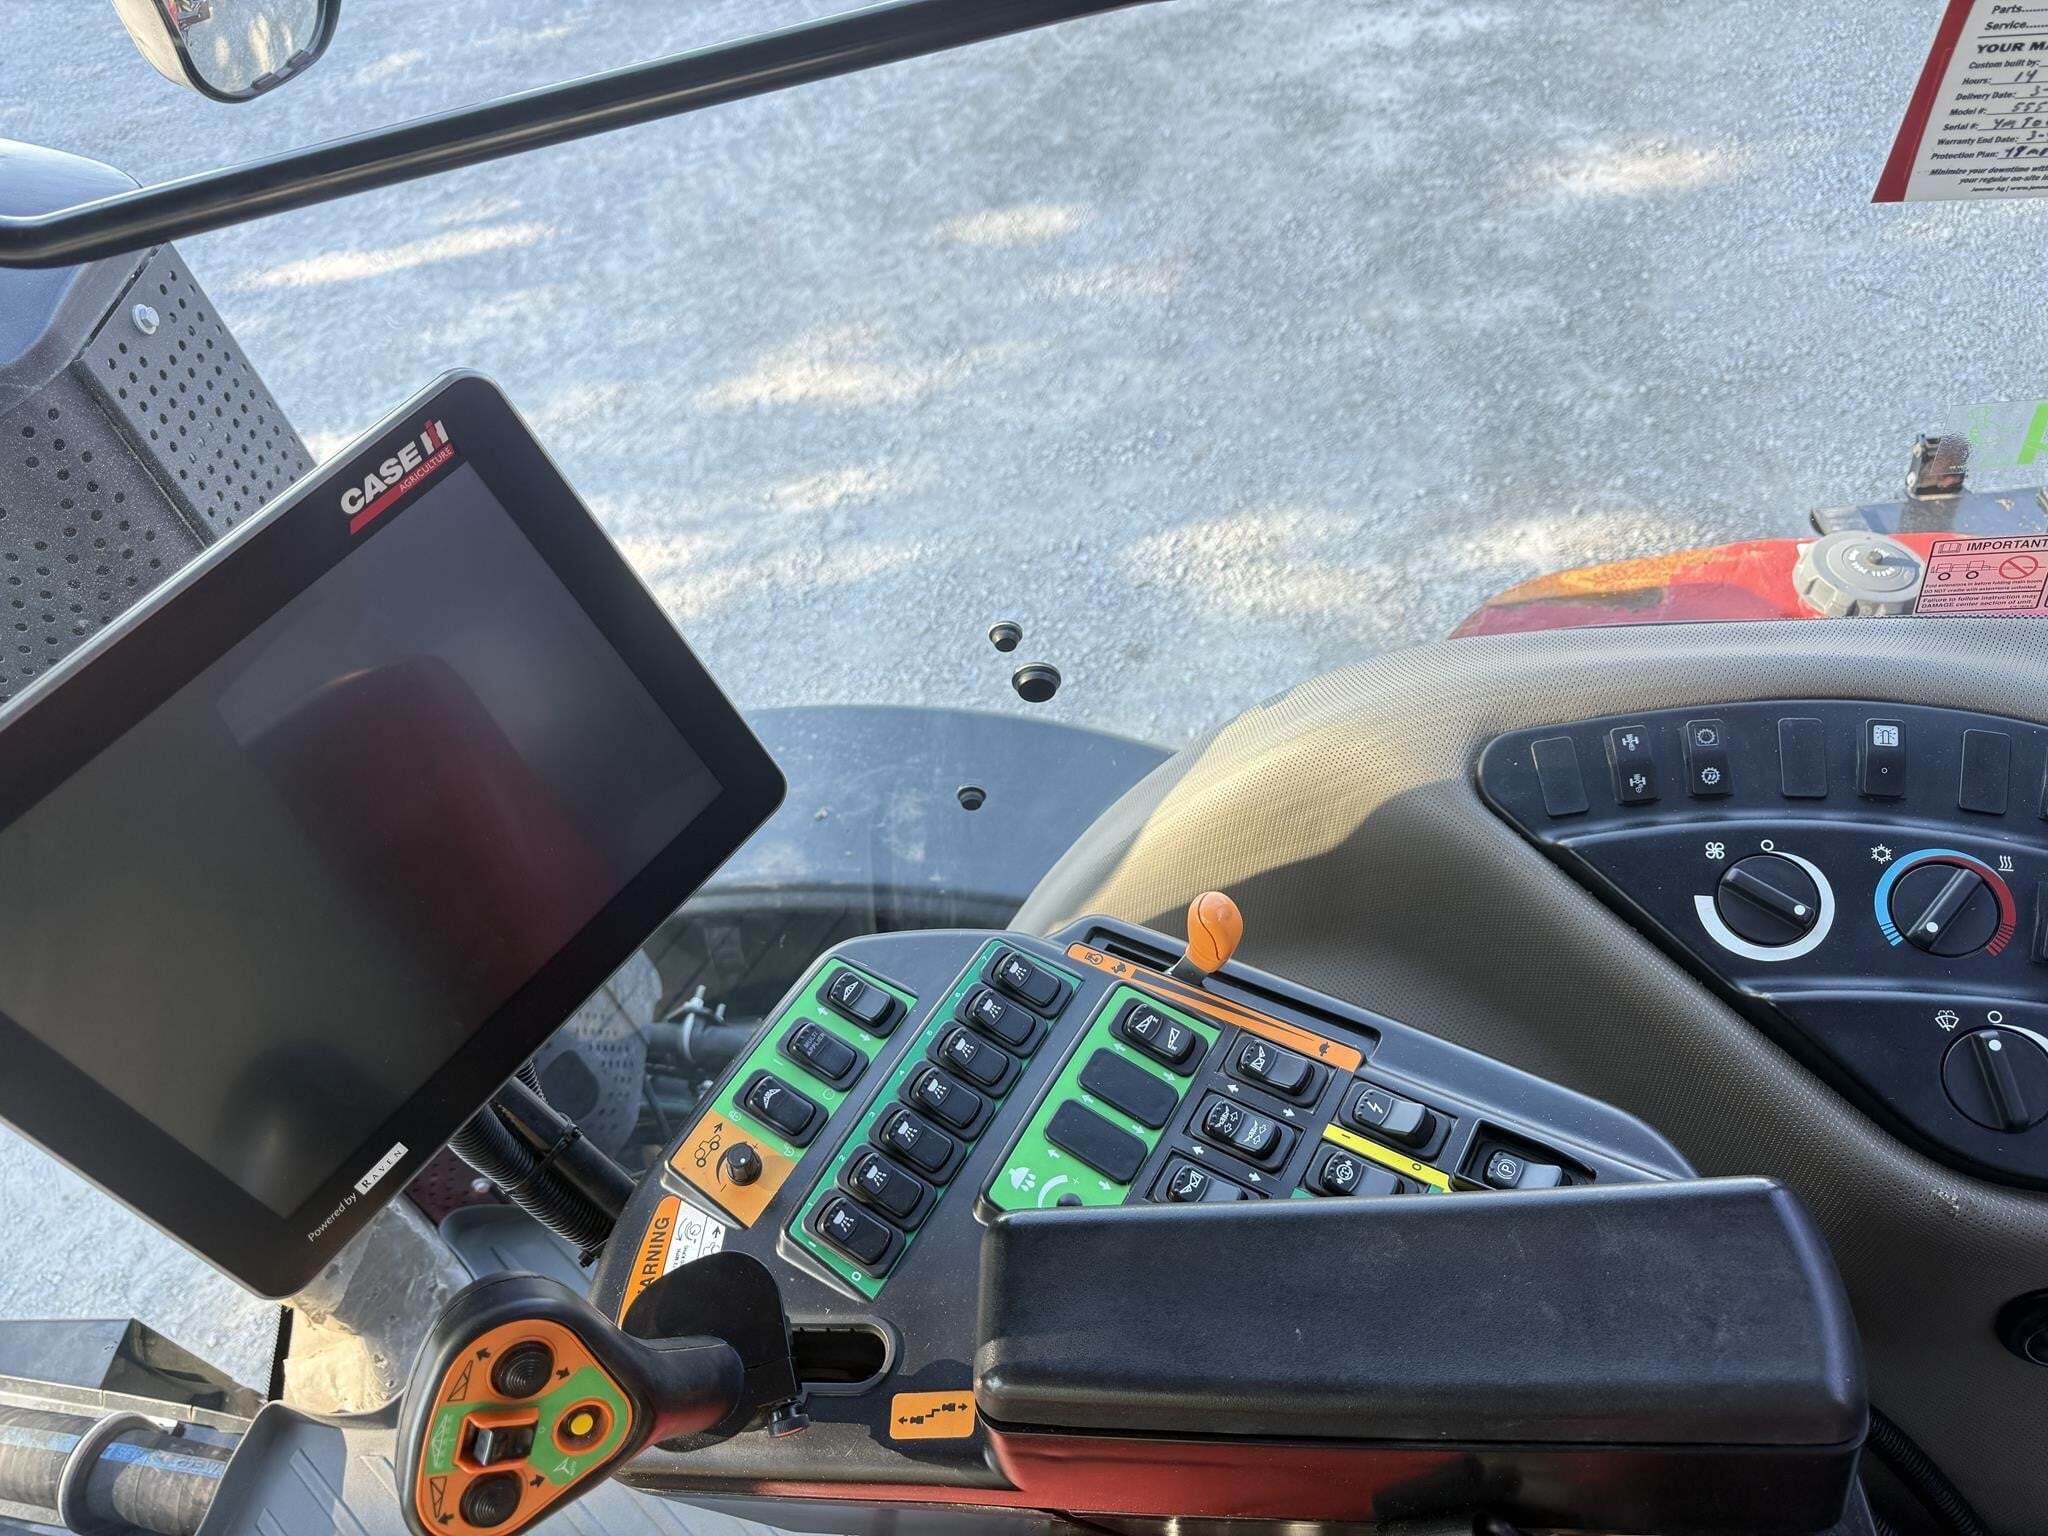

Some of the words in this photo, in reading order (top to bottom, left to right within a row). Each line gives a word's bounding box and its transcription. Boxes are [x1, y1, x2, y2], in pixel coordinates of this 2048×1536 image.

[1984, 21, 2027, 31] Service
[1977, 42, 2025, 54] YOUR
[1968, 61, 2002, 69] Custom
[2003, 59, 2024, 68] built
[1955, 93, 1990, 101] Delivery
[1991, 91, 2017, 99] Date:
[1949, 107, 1977, 116] Model
[1942, 122, 1968, 131] Serial
[1937, 138, 1975, 146] Warranty
[1976, 136, 1993, 144] End
[1994, 135, 2019, 144] Date:
[1930, 151, 1975, 160] Protection
[1976, 150, 1999, 159] Plan:
[1928, 167, 1967, 176] Minimize
[1967, 167, 1987, 175] your
[1987, 165, 2030, 174] downtime
[1959, 176, 1979, 185] your
[399, 446, 453, 493] AGRICULTURE
[340, 441, 422, 514] CASE
[1966, 539, 2048, 551] IMPORTANT
[361, 1150, 402, 1189] RAVEN
[307, 1201, 346, 1242] Powered
[344, 1192, 357, 1206] by
[637, 1216, 670, 1294] ARNING
